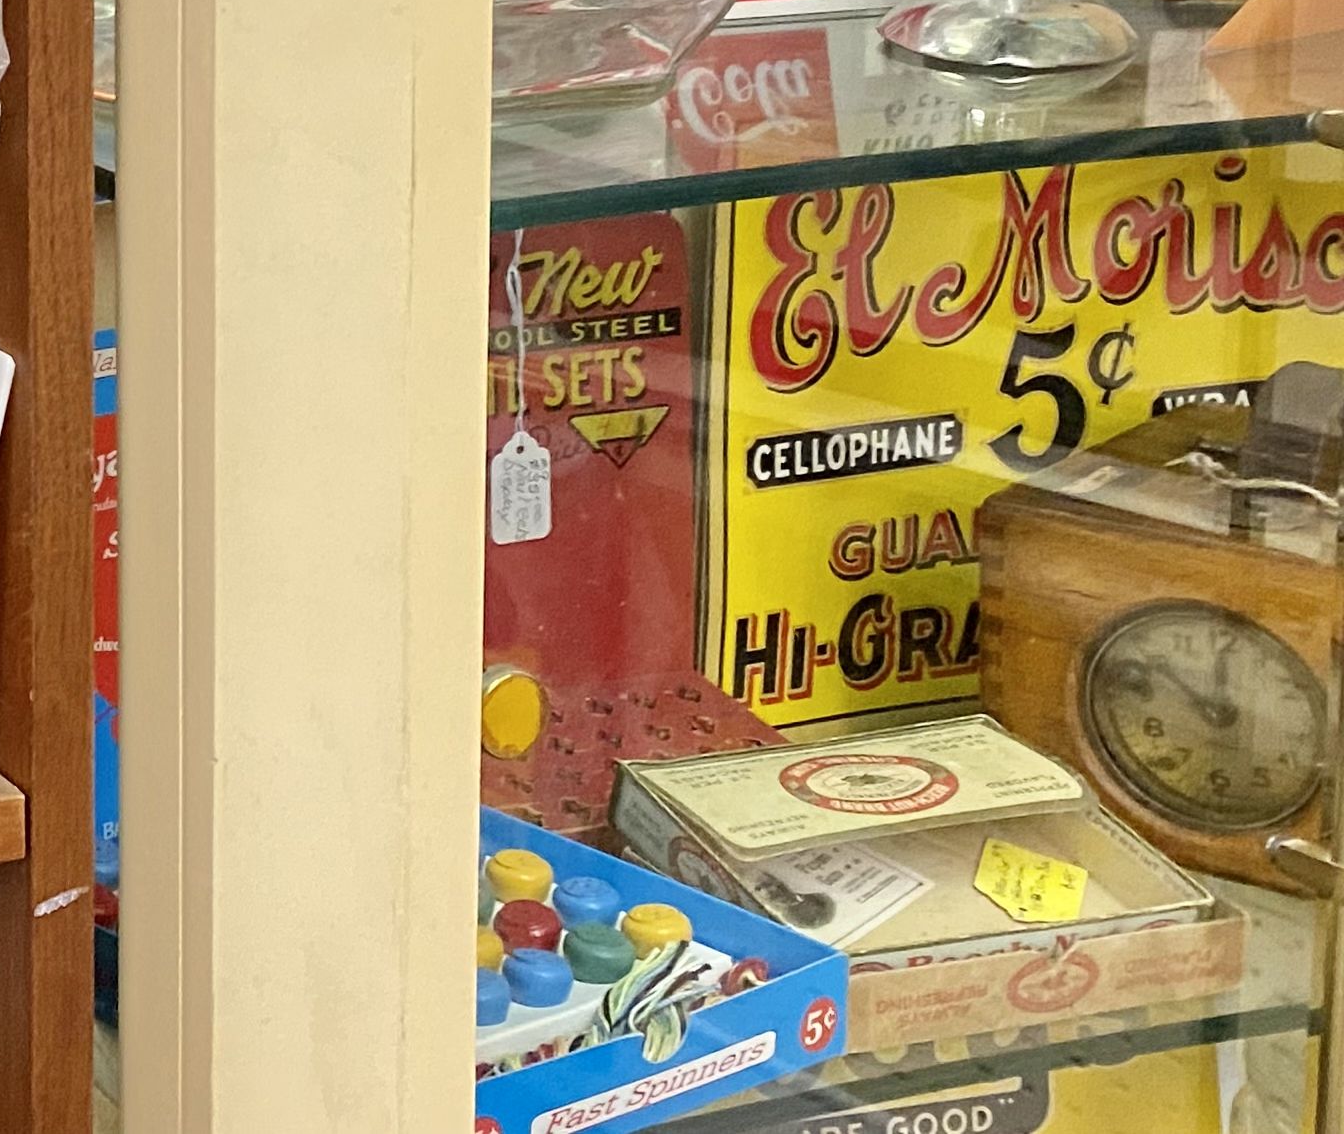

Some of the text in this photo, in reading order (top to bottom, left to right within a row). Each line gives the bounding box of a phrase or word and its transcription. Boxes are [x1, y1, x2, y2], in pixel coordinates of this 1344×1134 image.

[518, 245, 663, 316] New
[748, 181, 914, 393] El
[570, 313, 676, 341] STEEL
[542, 345, 647, 408] SETS
[989, 321, 1139, 474] 5¢
[752, 419, 958, 484] CELLOPHANE
[803, 1004, 837, 1045] 5¢
[546, 1039, 769, 1134] Fast Spinners
